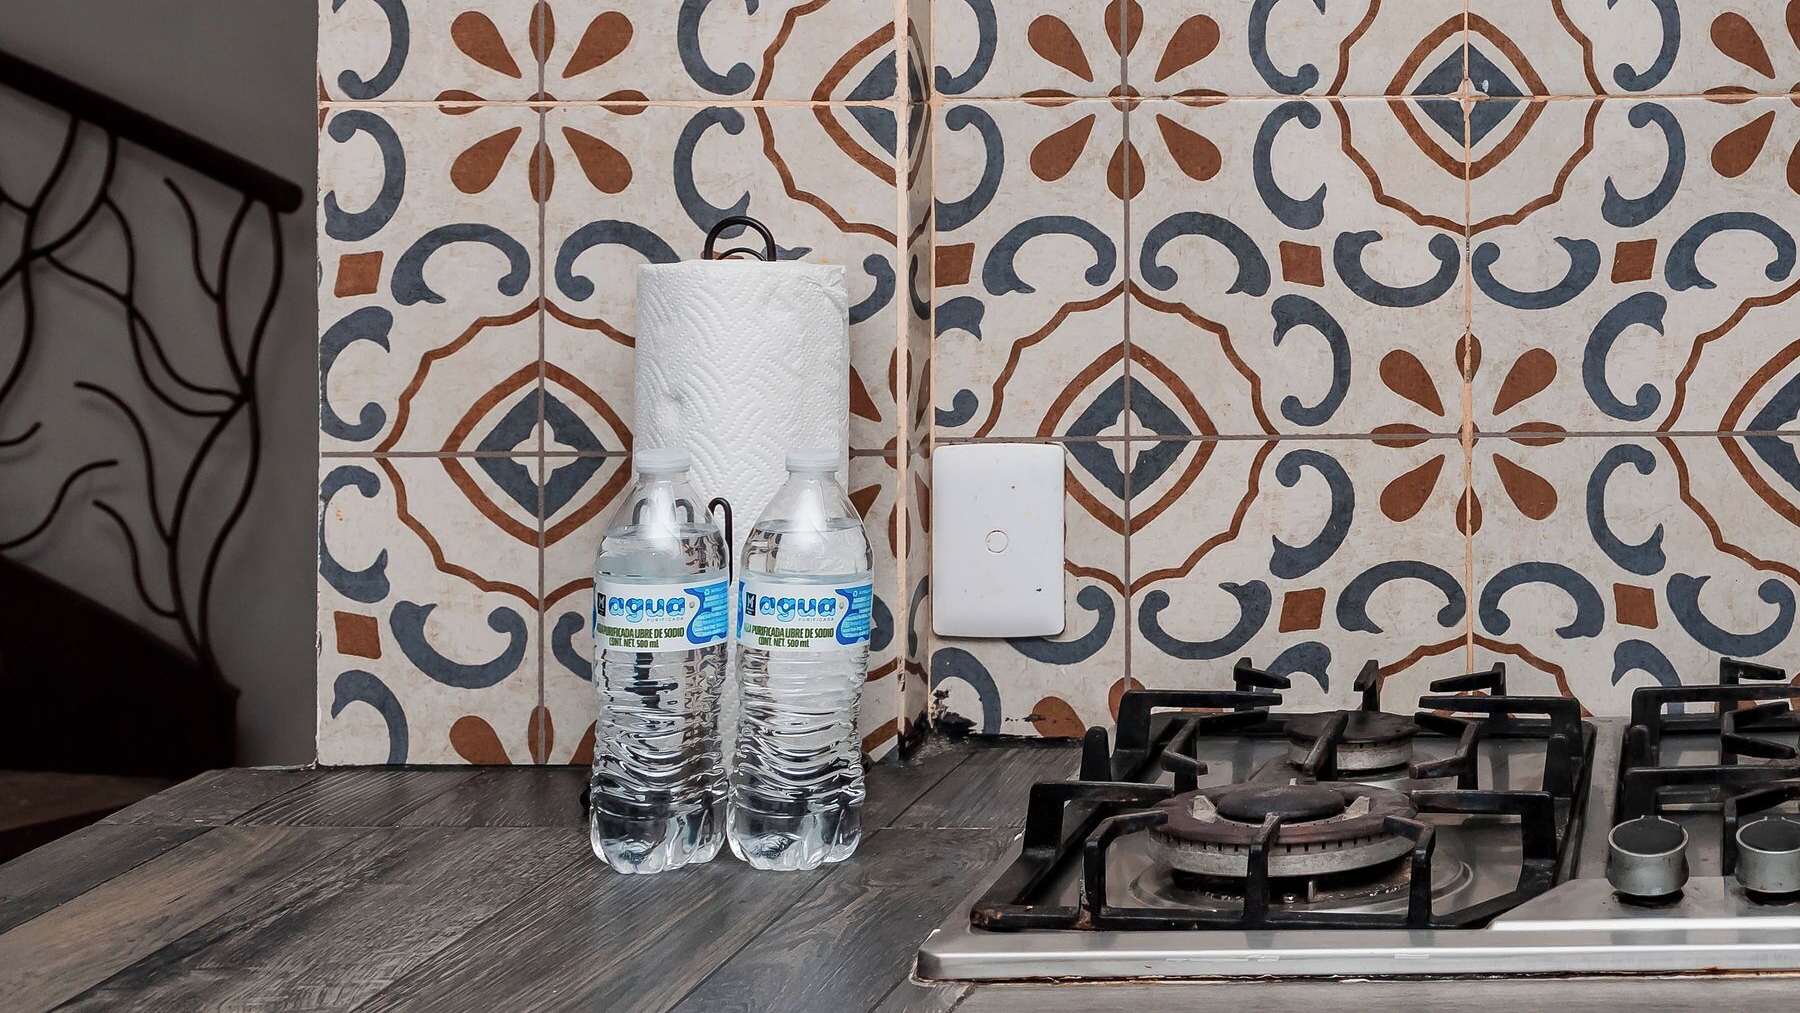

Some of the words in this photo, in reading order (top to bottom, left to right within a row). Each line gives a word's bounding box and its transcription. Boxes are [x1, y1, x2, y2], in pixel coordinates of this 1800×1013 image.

[608, 596, 686, 623] agua
[759, 596, 836, 622] agua
[635, 629, 653, 638] LIBRE
[654, 629, 663, 638] DE
[664, 627, 684, 638] SODIO
[785, 628, 803, 638] LIBRE
[804, 628, 813, 638] DE
[814, 628, 834, 638] SODIO
[636, 639, 648, 648] 500
[787, 639, 799, 647] 500
